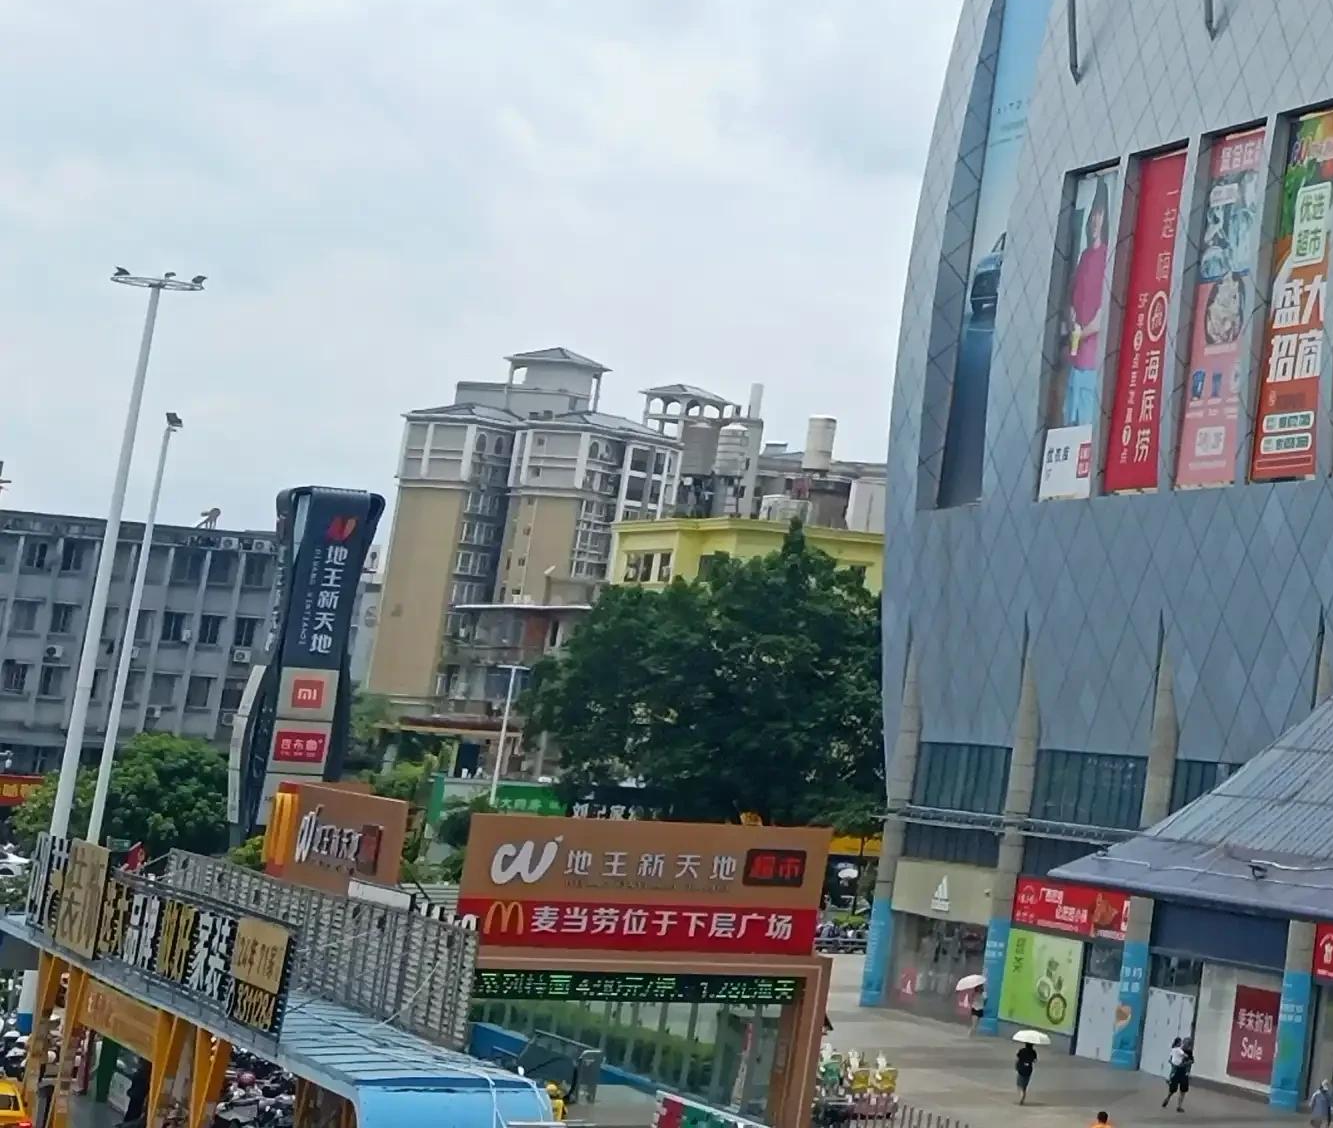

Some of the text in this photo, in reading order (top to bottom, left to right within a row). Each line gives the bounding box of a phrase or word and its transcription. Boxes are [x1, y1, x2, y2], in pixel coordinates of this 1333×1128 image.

[1272, 275, 1328, 329] 盛大
[1266, 330, 1325, 383] 招商
[308, 544, 349, 654] 地王新天地
[566, 849, 803, 881] 地王新天地 超市
[531, 905, 793, 940] 麦当劳位于下层广场
[1240, 1037, 1263, 1061] Sale
